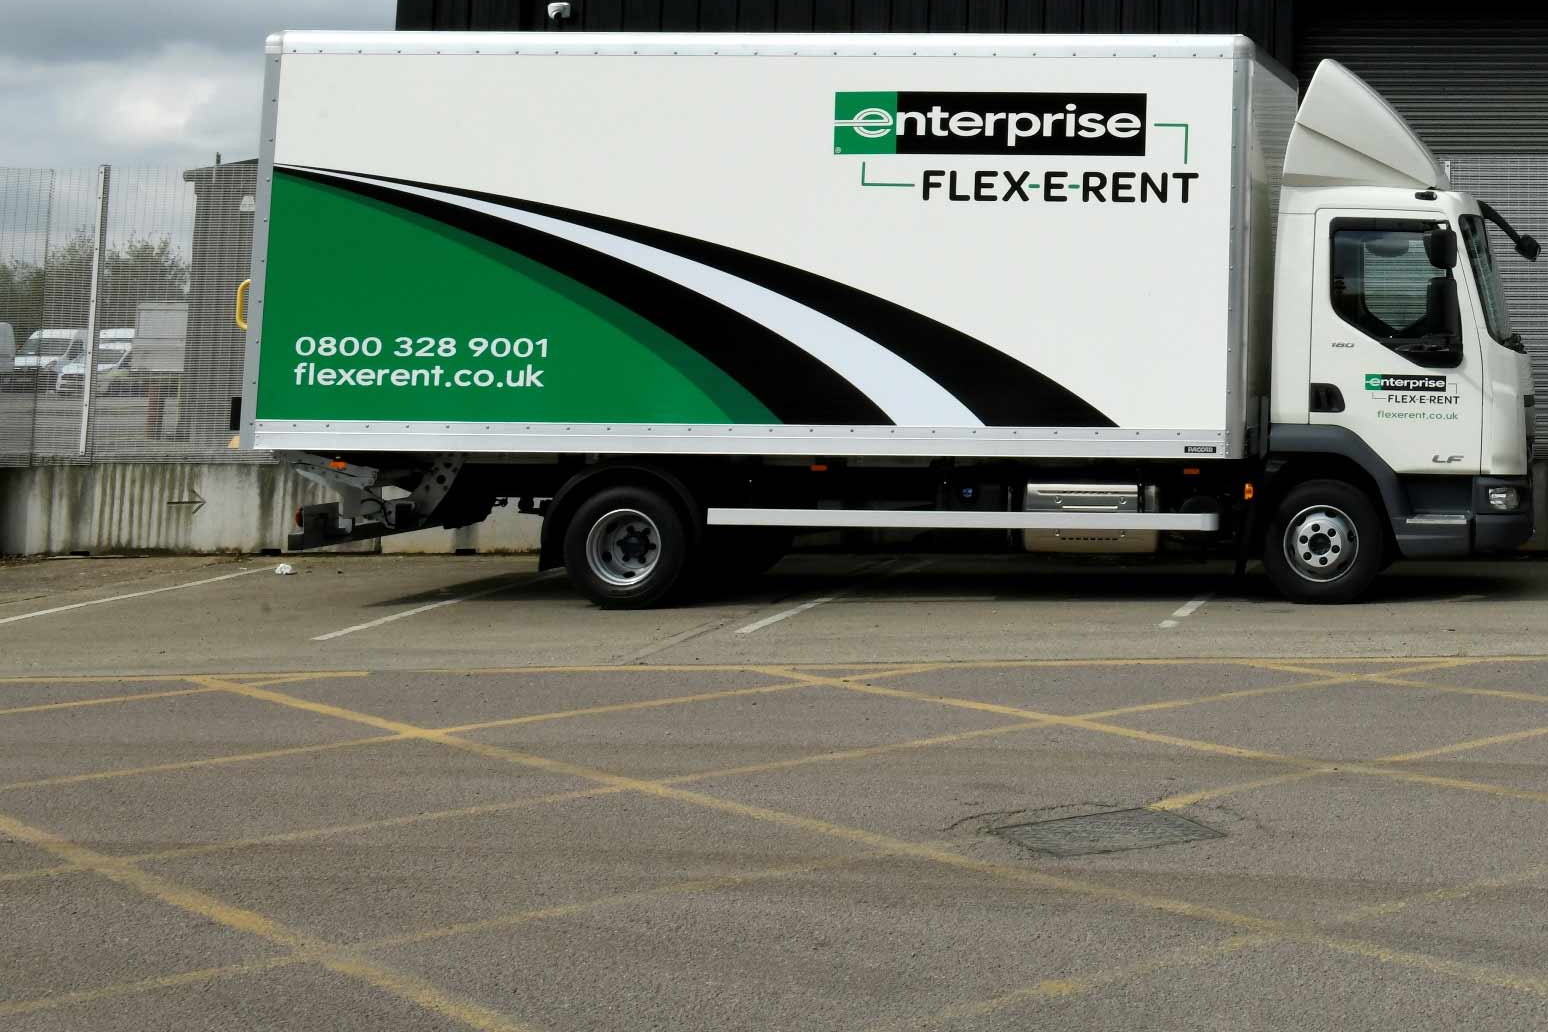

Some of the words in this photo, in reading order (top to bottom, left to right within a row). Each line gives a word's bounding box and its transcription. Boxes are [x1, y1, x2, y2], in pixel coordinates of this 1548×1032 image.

[853, 103, 1142, 147] enterprise
[921, 169, 1200, 204] FLEX-E-RENT
[295, 336, 382, 357] 0800
[393, 336, 458, 358] 328
[468, 337, 549, 358] 9001
[294, 362, 545, 388] flexerent.co.uk
[1369, 377, 1445, 389] enterprise
[1387, 394, 1460, 405] FLEX-E-RENT
[1377, 410, 1459, 420] flexerent.co.uk
[1432, 454, 1464, 464] LF
